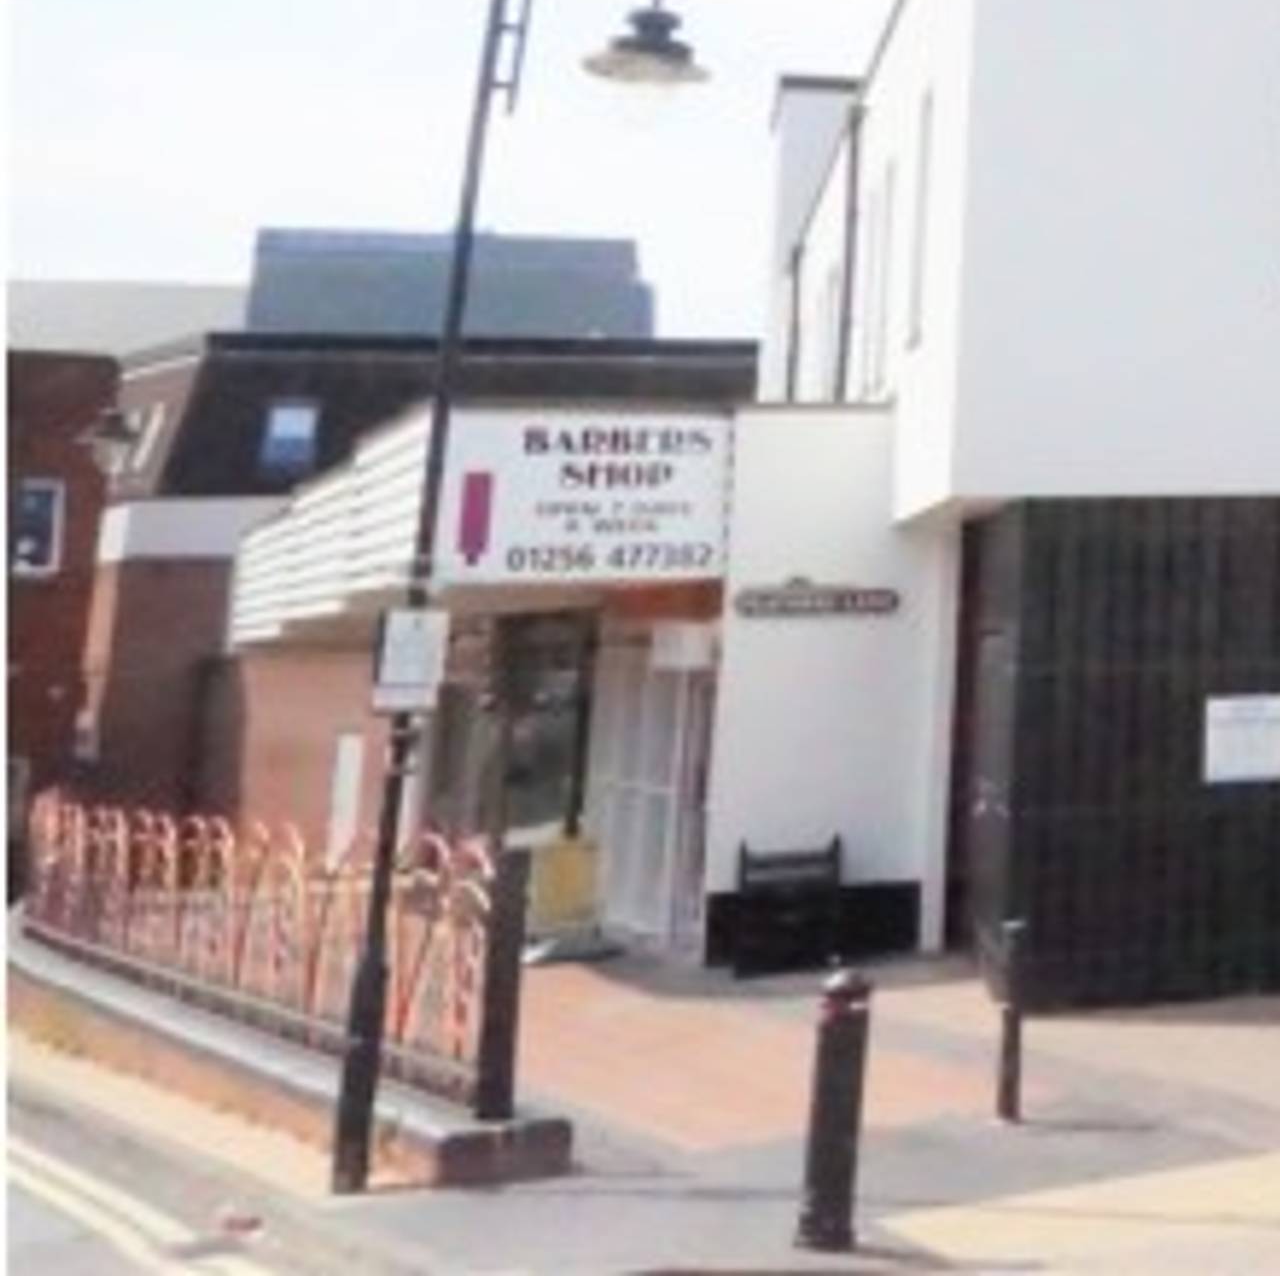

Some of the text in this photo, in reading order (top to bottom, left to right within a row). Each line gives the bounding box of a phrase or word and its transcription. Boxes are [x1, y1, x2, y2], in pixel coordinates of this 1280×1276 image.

[523, 427, 712, 456] BARBERS
[560, 462, 674, 490] SHOP
[506, 544, 596, 572] 01256
